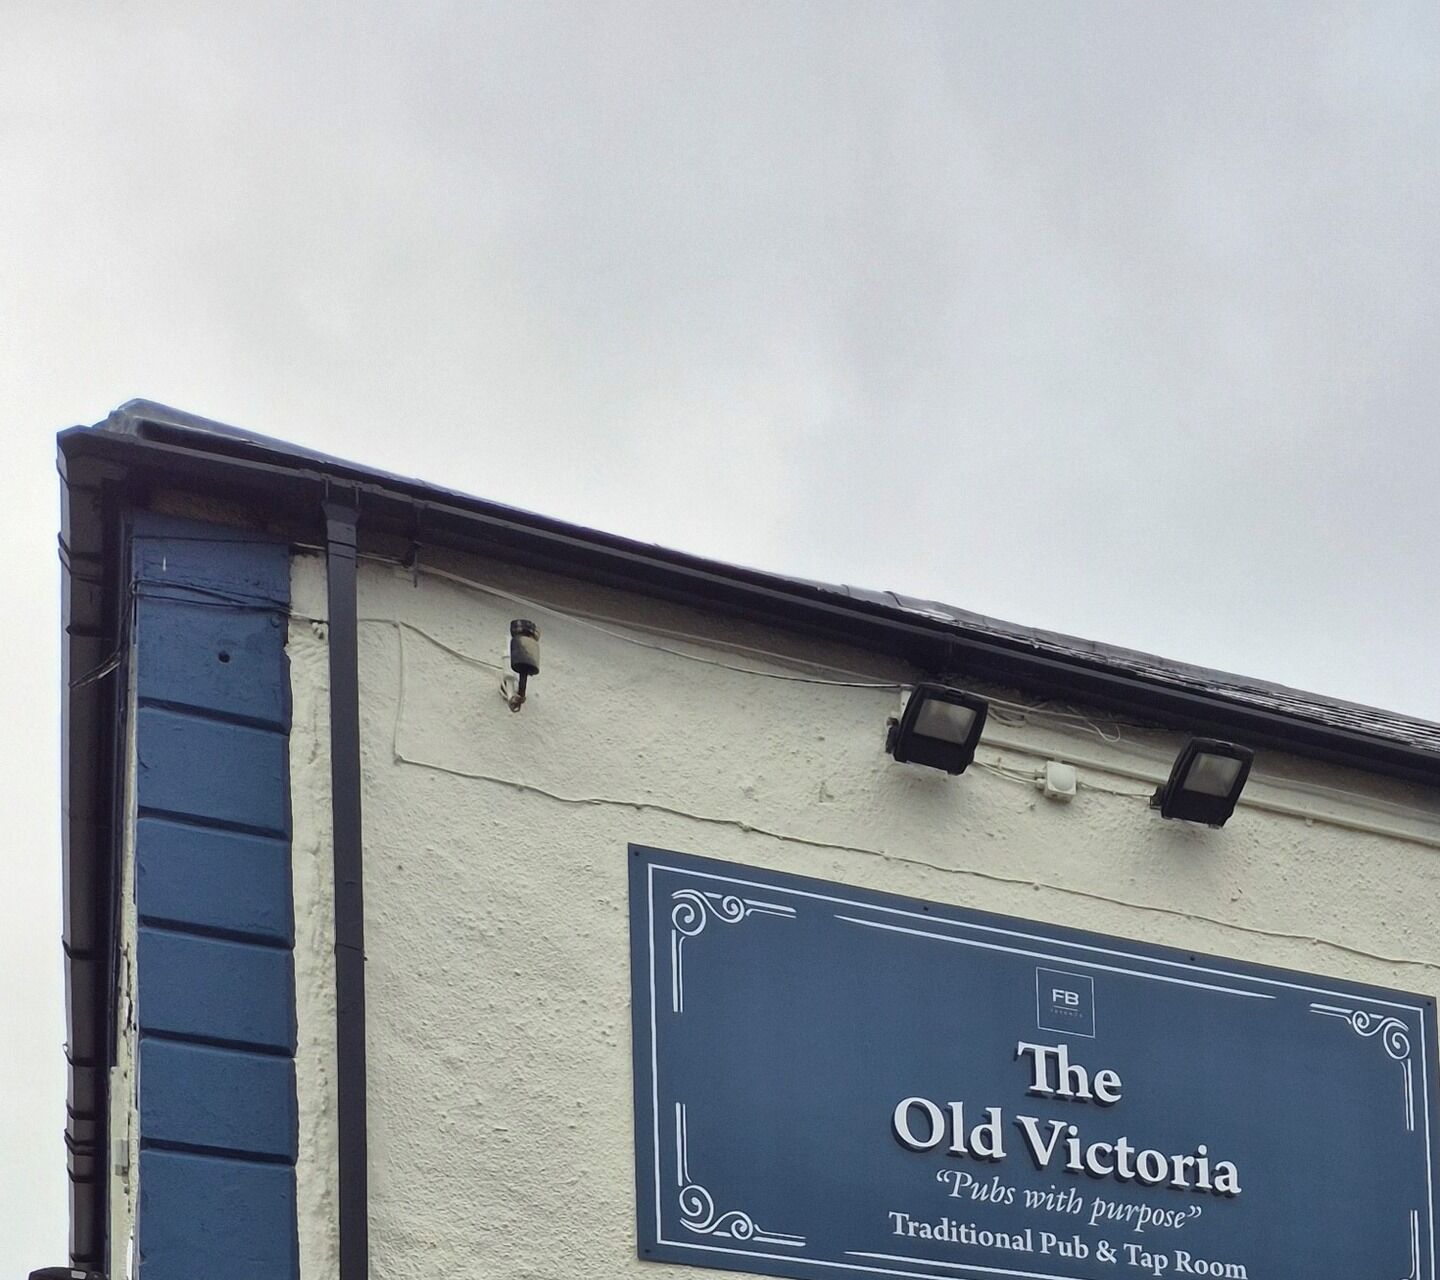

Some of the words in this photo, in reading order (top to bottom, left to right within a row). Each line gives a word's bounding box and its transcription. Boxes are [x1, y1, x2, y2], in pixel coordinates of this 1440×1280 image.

[1052, 988, 1079, 1005] FB
[1018, 1041, 1122, 1103] The
[894, 1097, 1007, 1158] Old
[1017, 1115, 1242, 1194] Victoria
[1023, 1187, 1083, 1214] with
[888, 1211, 1034, 1252] Traditional
[1039, 1231, 1089, 1260] Pub
[1096, 1240, 1117, 1264] &
[1123, 1243, 1169, 1276] Tap
[1174, 1250, 1248, 1280] Room
